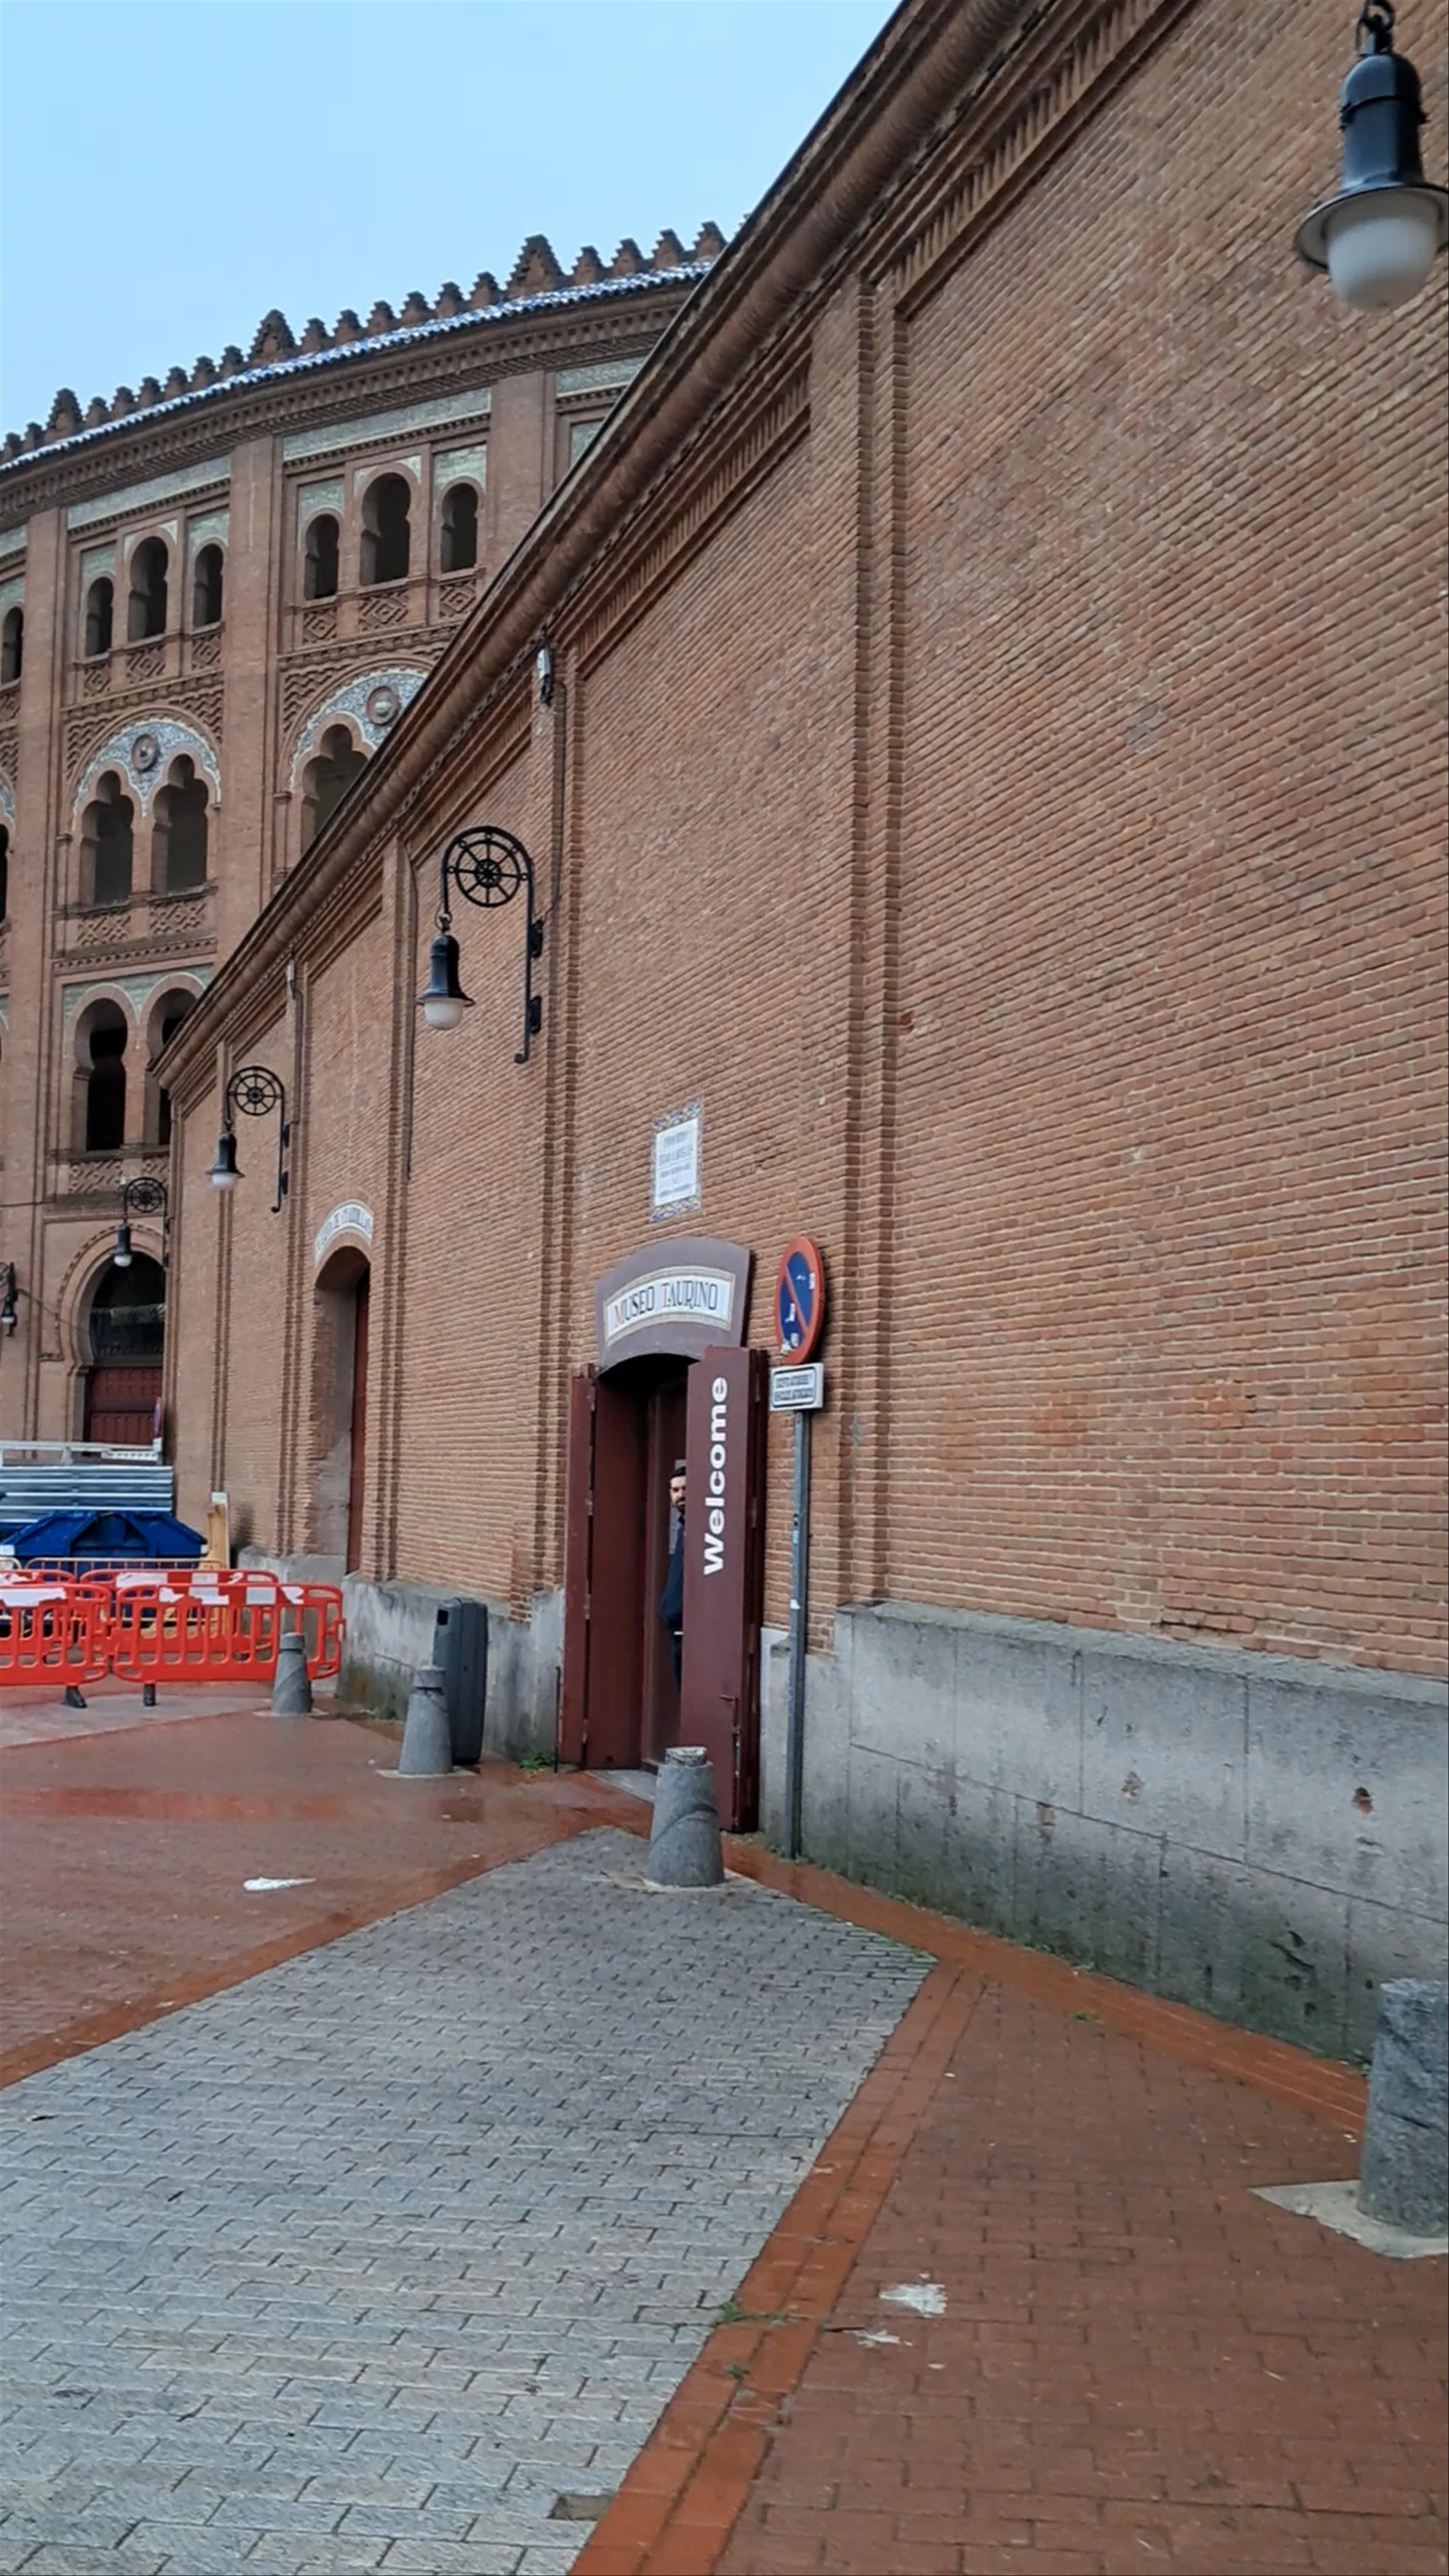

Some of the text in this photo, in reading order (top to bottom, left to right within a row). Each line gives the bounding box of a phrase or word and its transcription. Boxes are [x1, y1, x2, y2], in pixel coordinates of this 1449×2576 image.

[614, 1280, 718, 1328] MUSEO TAURINO
[703, 1377, 728, 1575] Welcome
